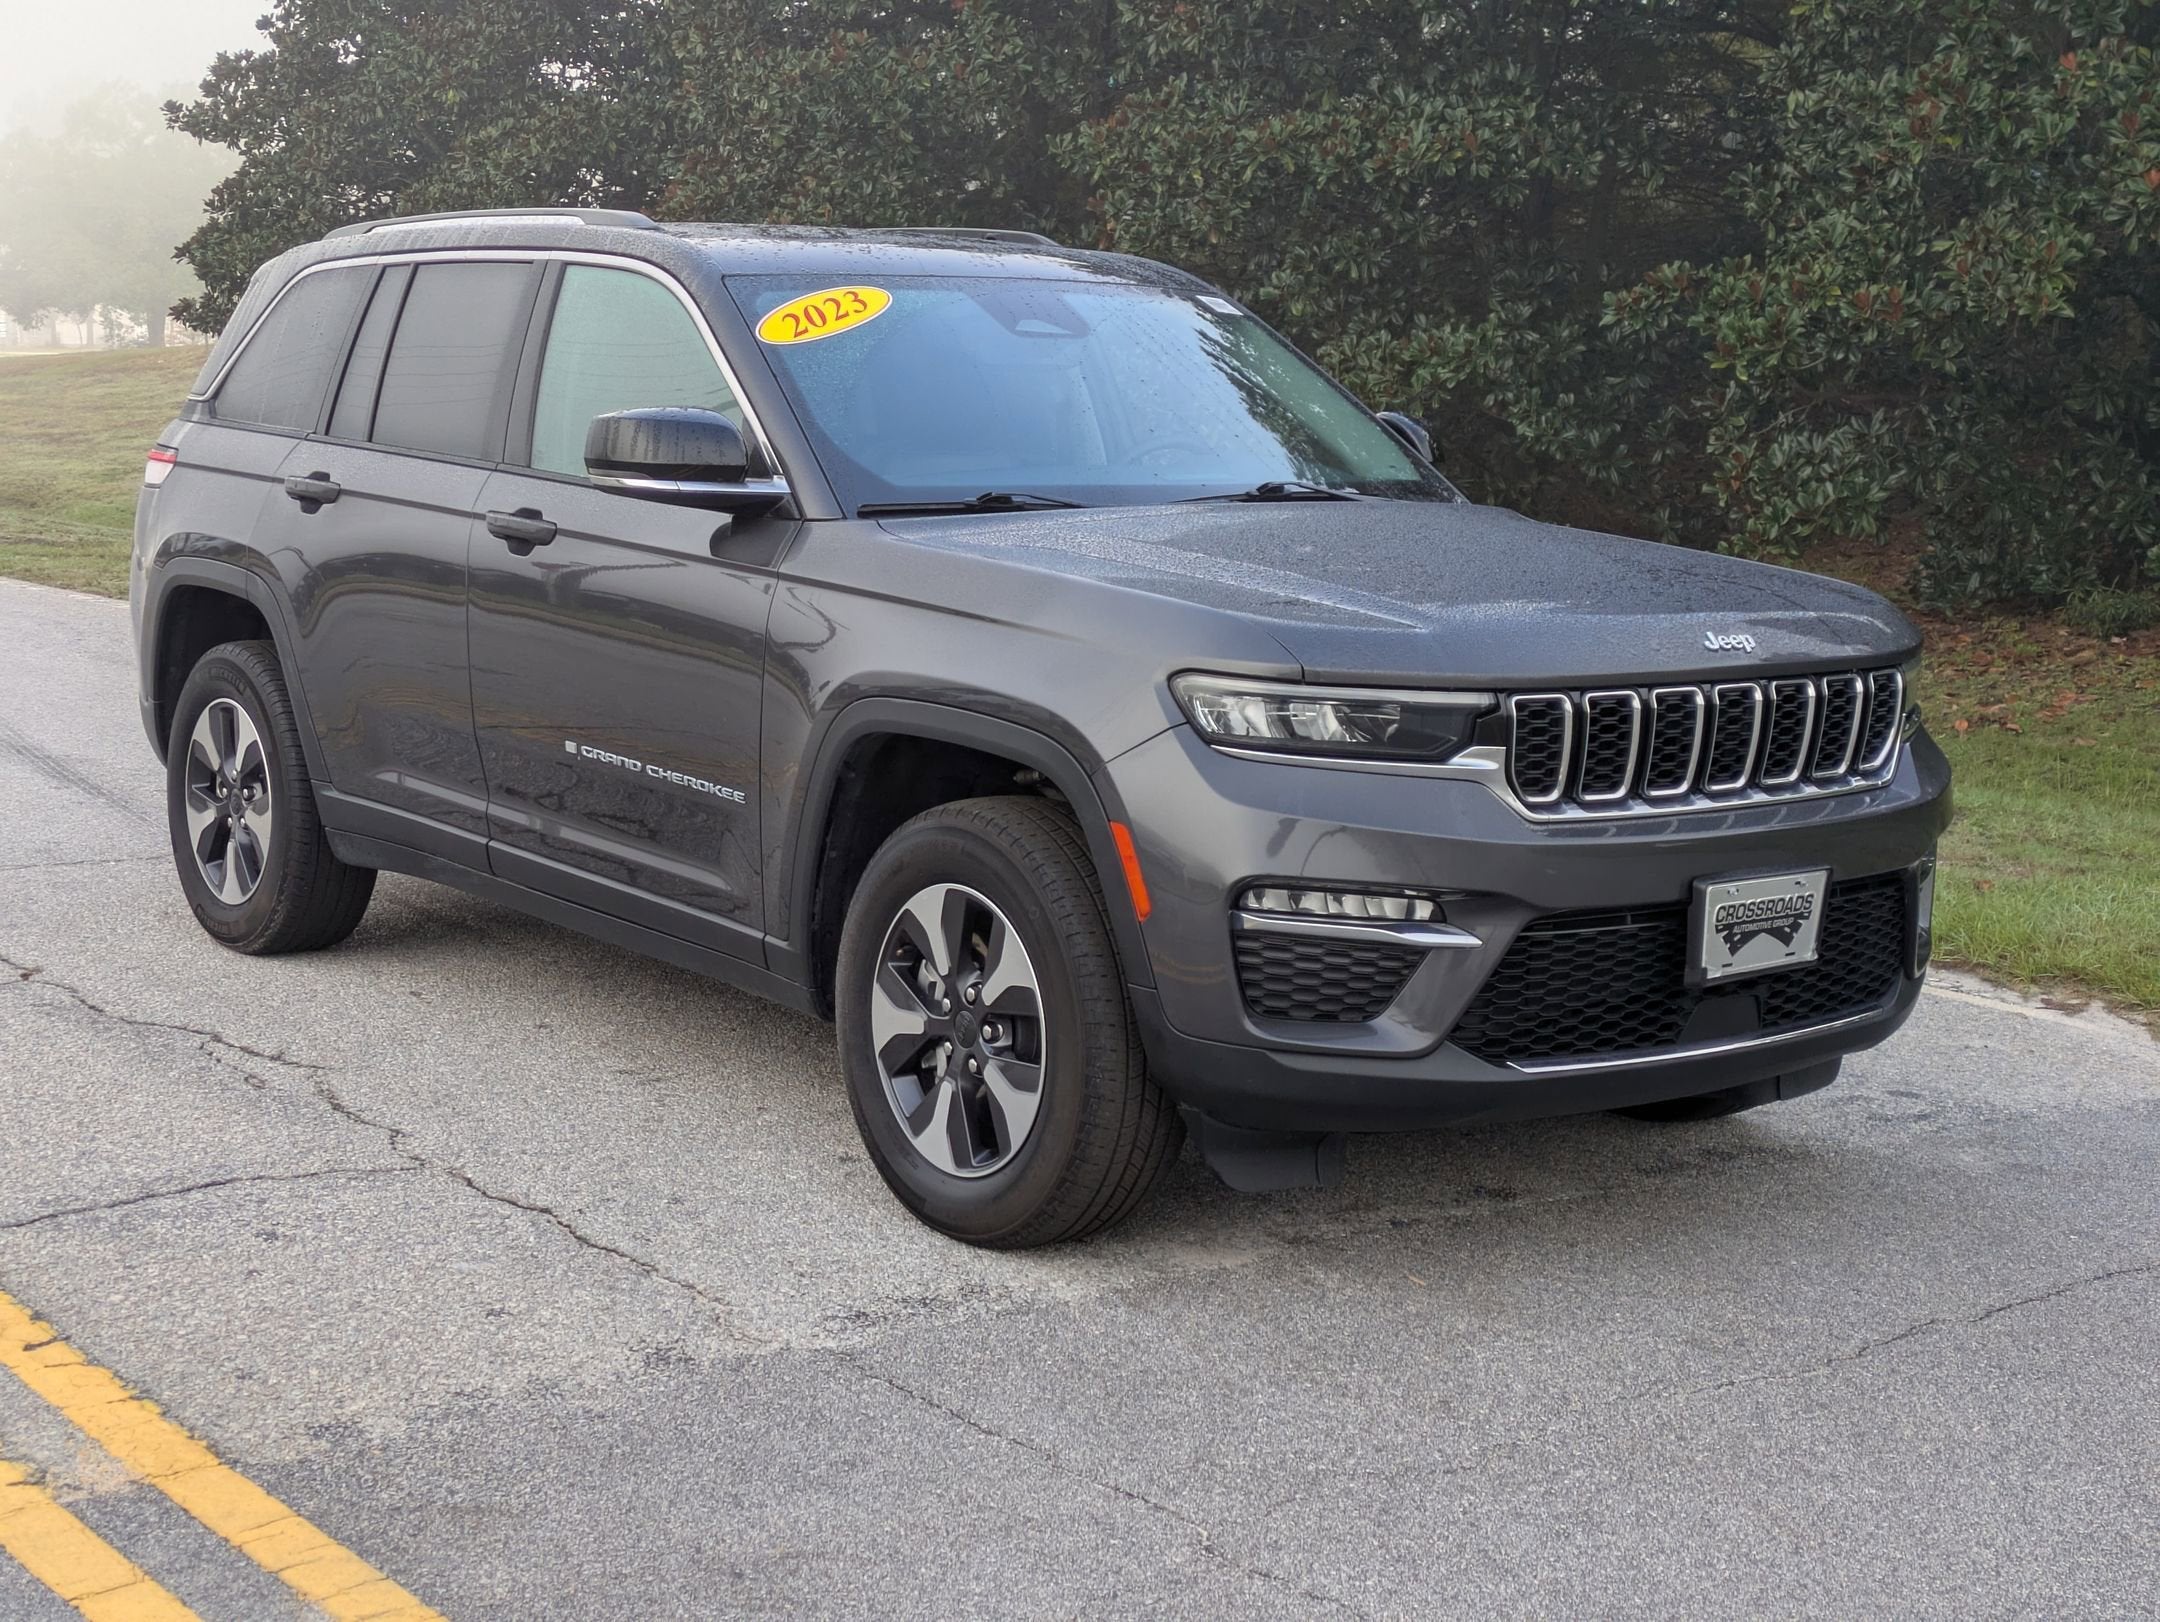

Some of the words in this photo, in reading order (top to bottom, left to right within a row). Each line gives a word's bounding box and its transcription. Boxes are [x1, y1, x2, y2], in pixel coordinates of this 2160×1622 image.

[782, 290, 868, 338] 2023
[1704, 631, 1756, 653] Jeep
[580, 745, 642, 772] GRAND
[646, 764, 747, 804] CHEROKEE
[1715, 892, 1815, 923] CROSSROADS
[1733, 920, 1772, 933] AUTOMOTIVE
[1773, 917, 1795, 928] GROUP
